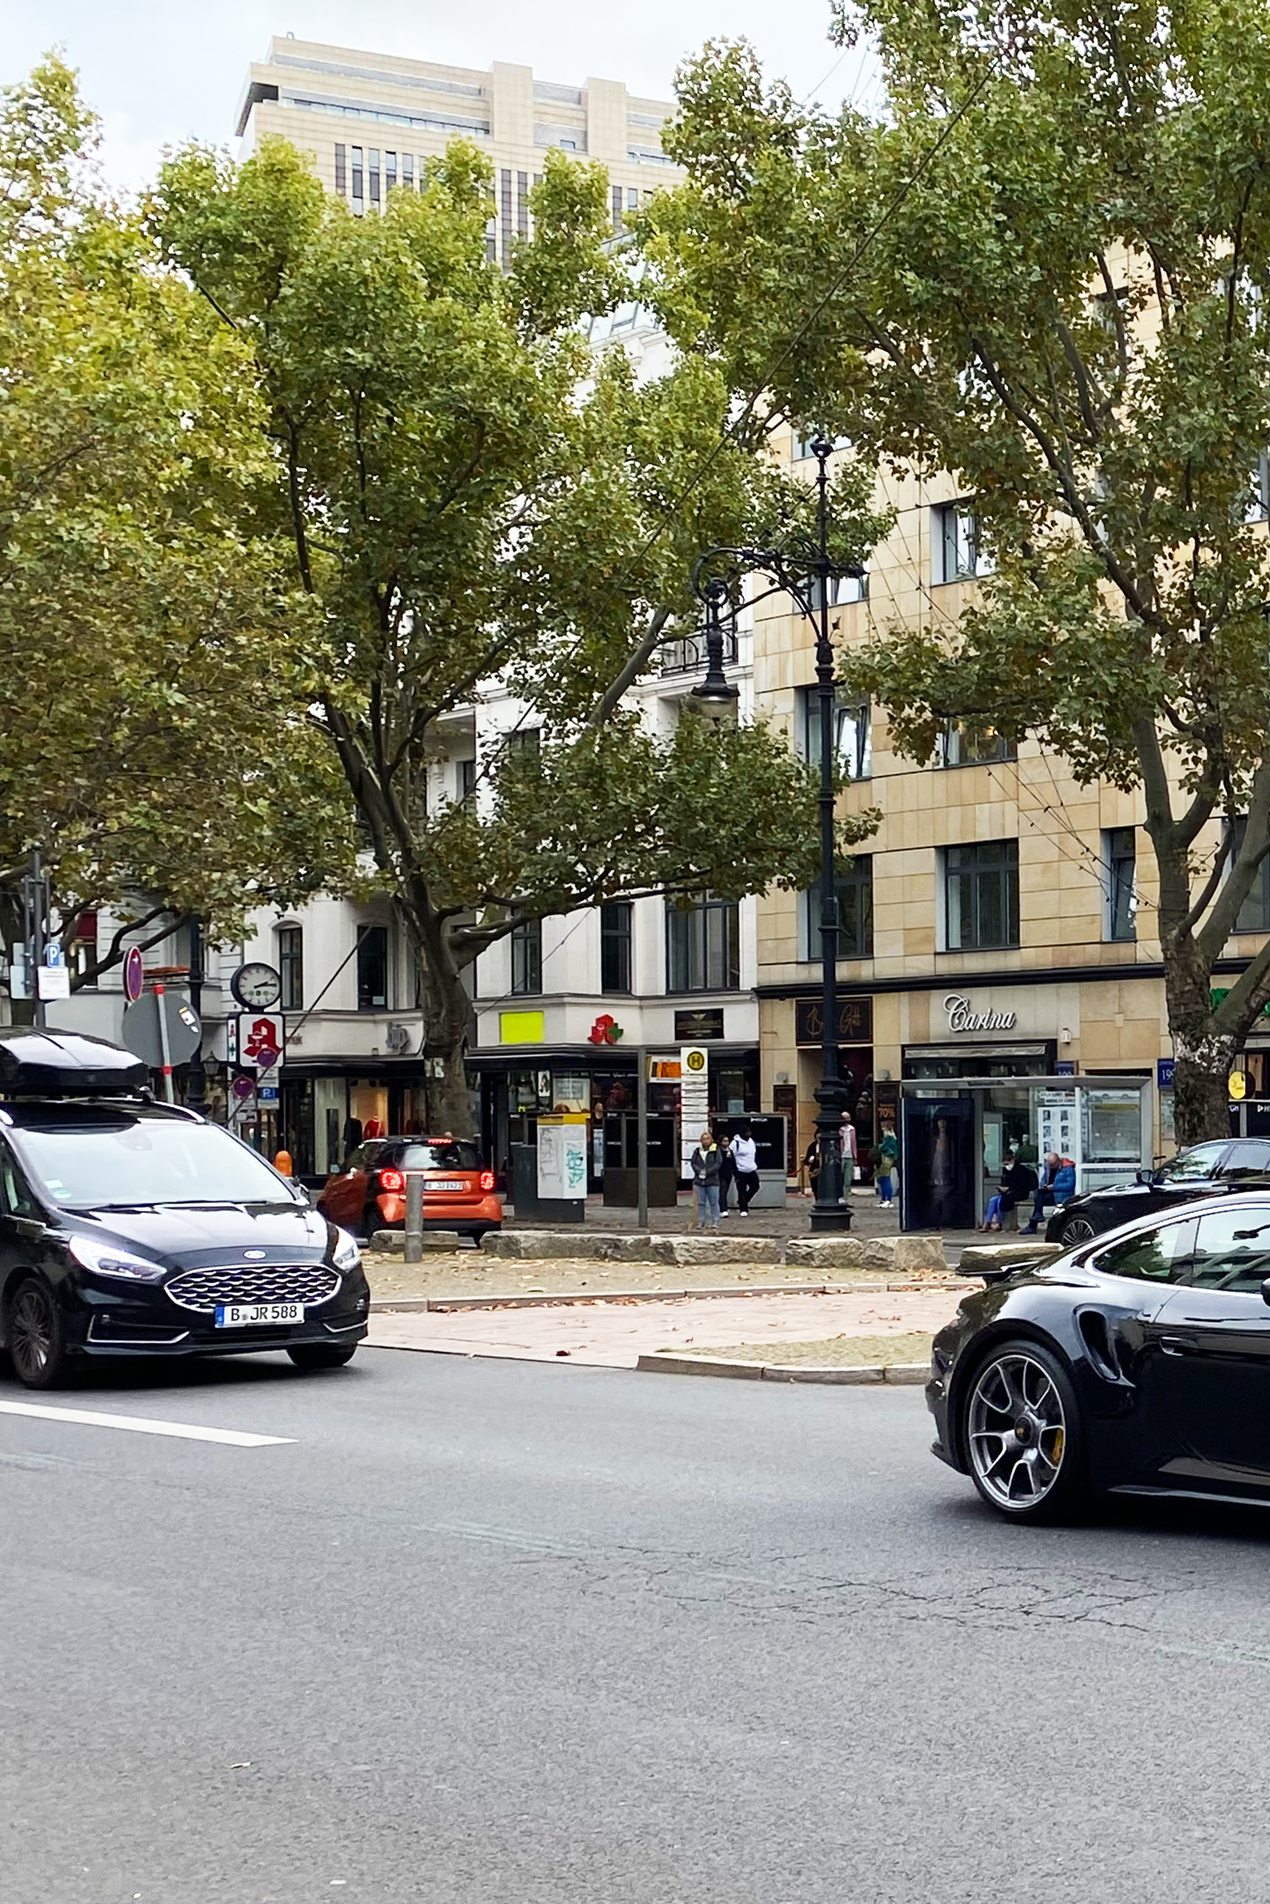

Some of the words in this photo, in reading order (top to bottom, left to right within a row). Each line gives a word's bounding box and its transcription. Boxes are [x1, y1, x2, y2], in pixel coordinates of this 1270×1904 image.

[943, 993, 1017, 1032] Carina
[691, 1056, 700, 1066] H
[231, 1307, 240, 1322] B
[250, 1307, 268, 1320] JR
[271, 1304, 298, 1319] 588
